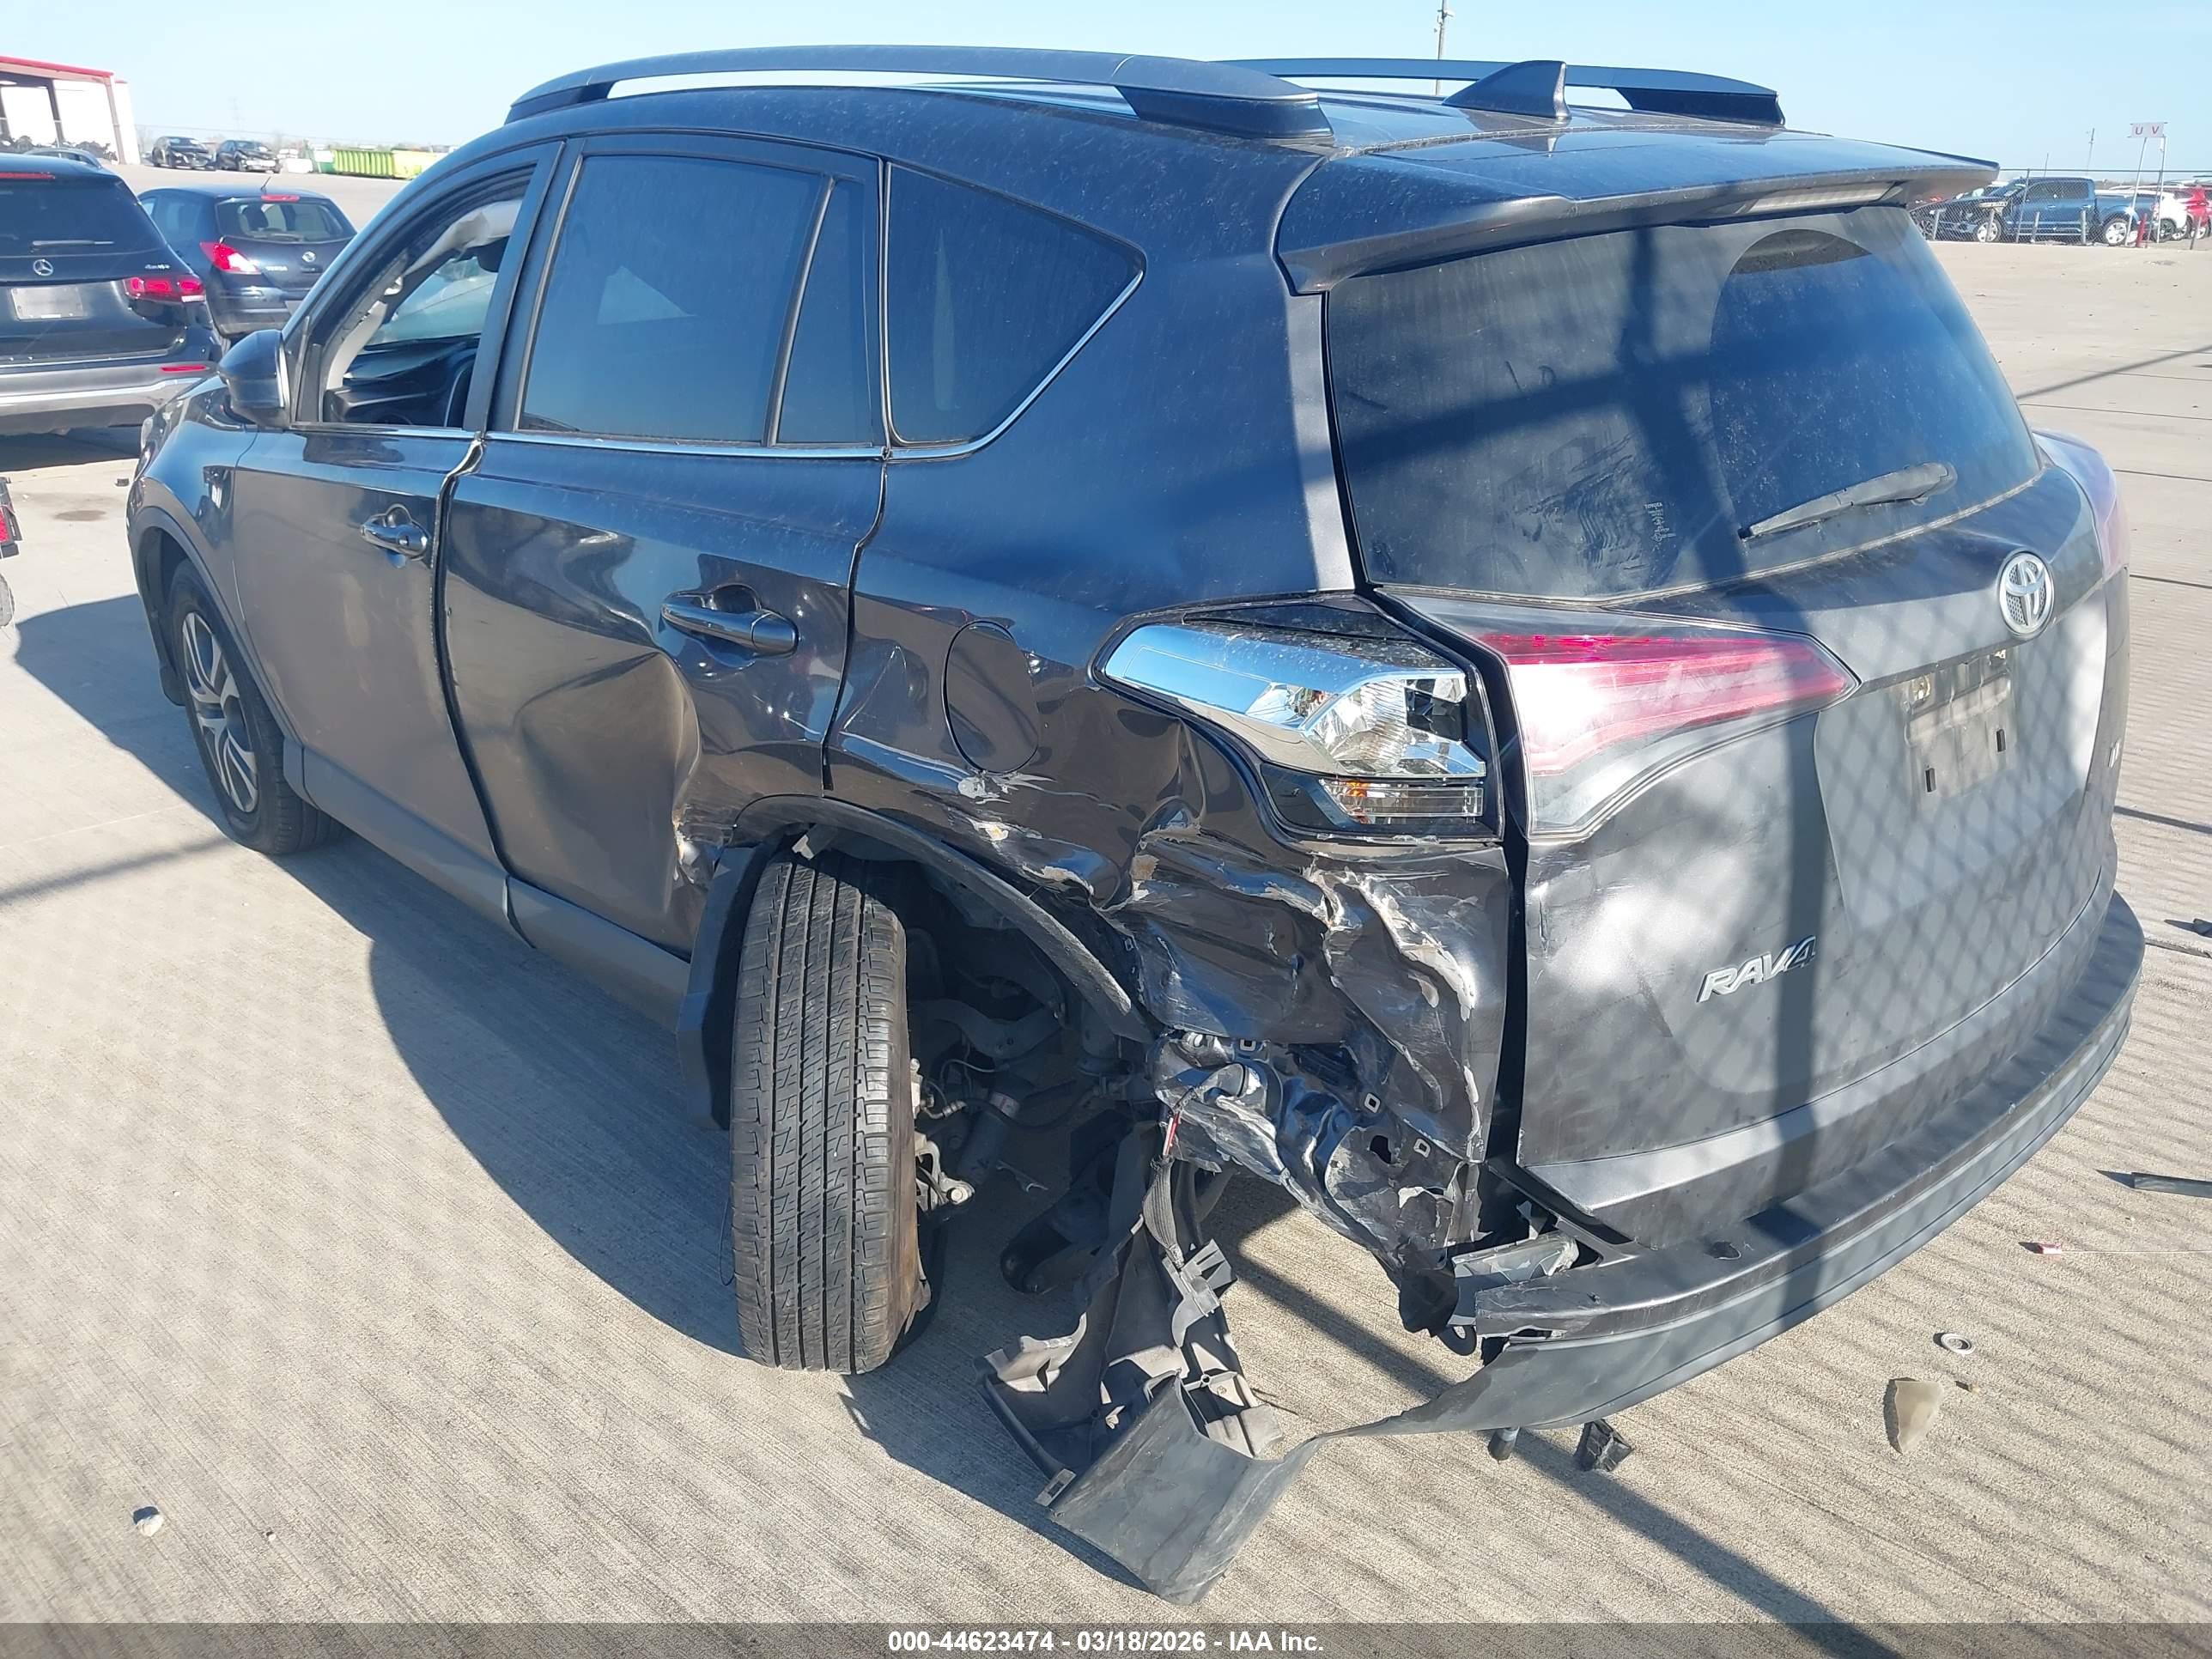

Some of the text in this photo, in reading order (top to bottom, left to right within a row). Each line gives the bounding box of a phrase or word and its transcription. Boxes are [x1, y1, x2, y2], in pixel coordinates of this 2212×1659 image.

[2135, 125, 2160, 136] U V
[1644, 501, 1663, 510] TOYOTA
[1695, 934, 1817, 1004] RAV4
